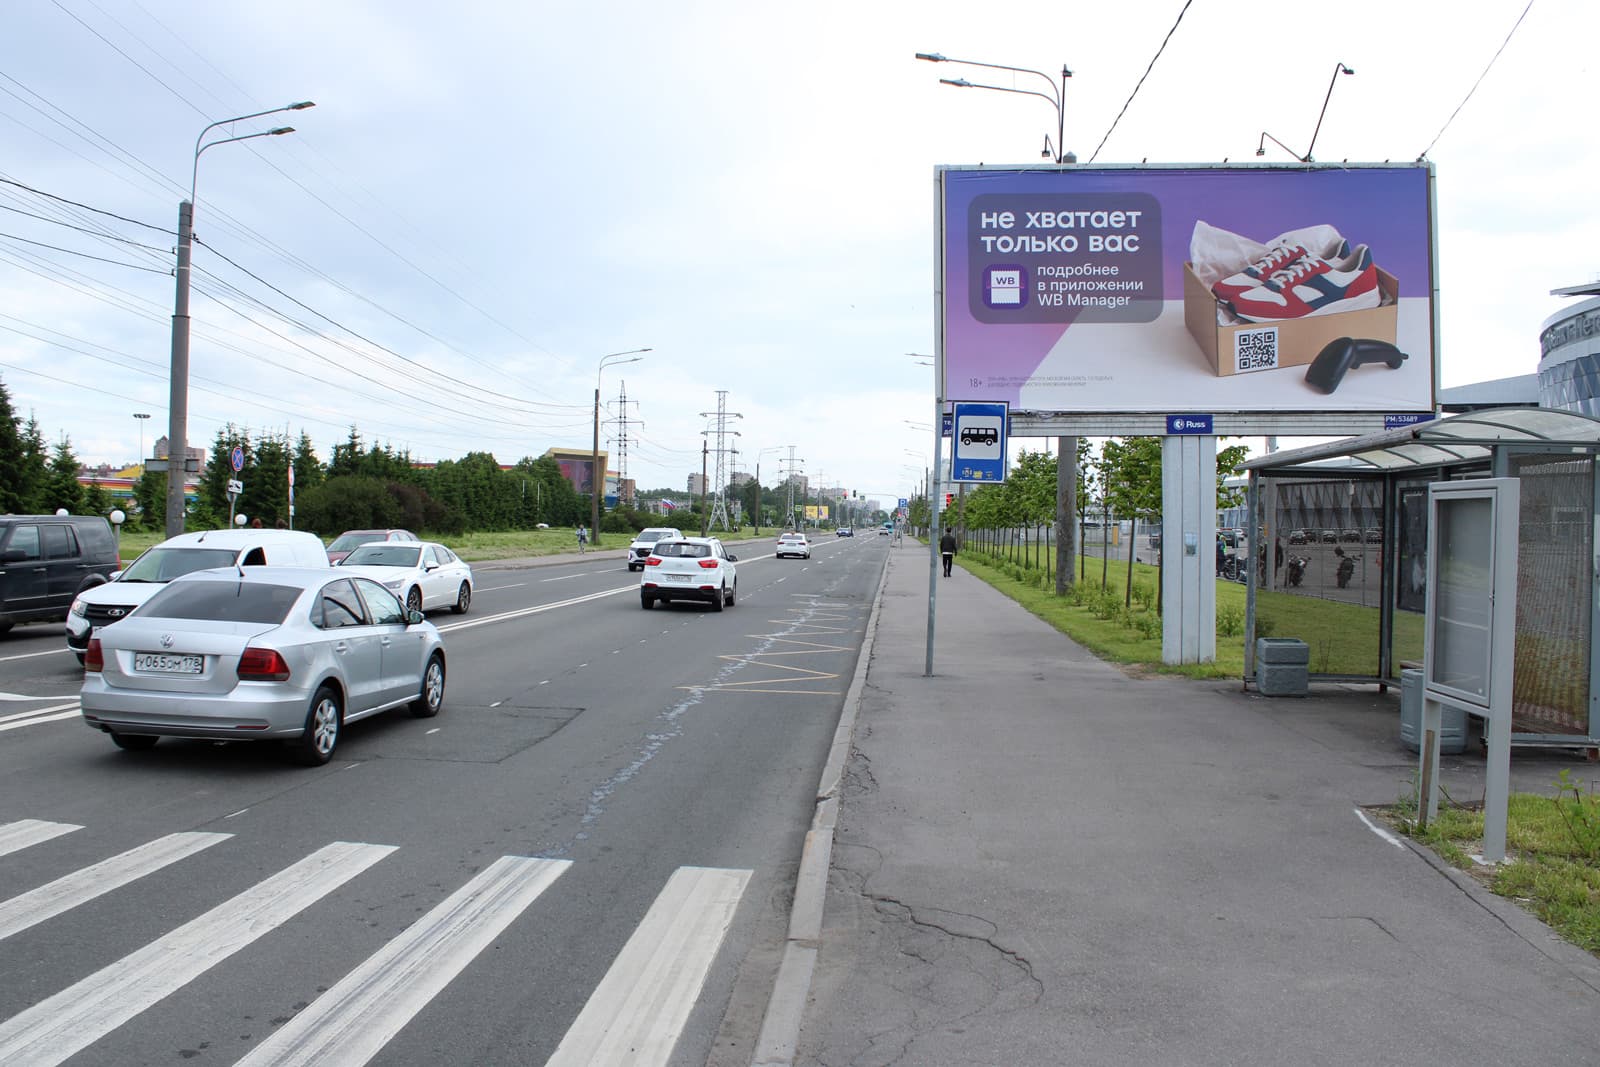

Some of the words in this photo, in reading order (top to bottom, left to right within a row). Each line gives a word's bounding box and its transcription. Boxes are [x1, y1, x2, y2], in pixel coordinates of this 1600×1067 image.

[981, 211, 1015, 229] не
[1025, 210, 1142, 229] хватает
[981, 235, 1079, 253] только
[1088, 234, 1140, 252] вас
[1037, 263, 1119, 278] подробнее
[995, 276, 1016, 285] WB
[1037, 281, 1046, 291] в
[1050, 280, 1144, 293] приложении
[1037, 293, 1063, 306] WB
[1068, 293, 1131, 308] Manager
[969, 378, 983, 388] 18+
[1186, 420, 1206, 428] Russ
